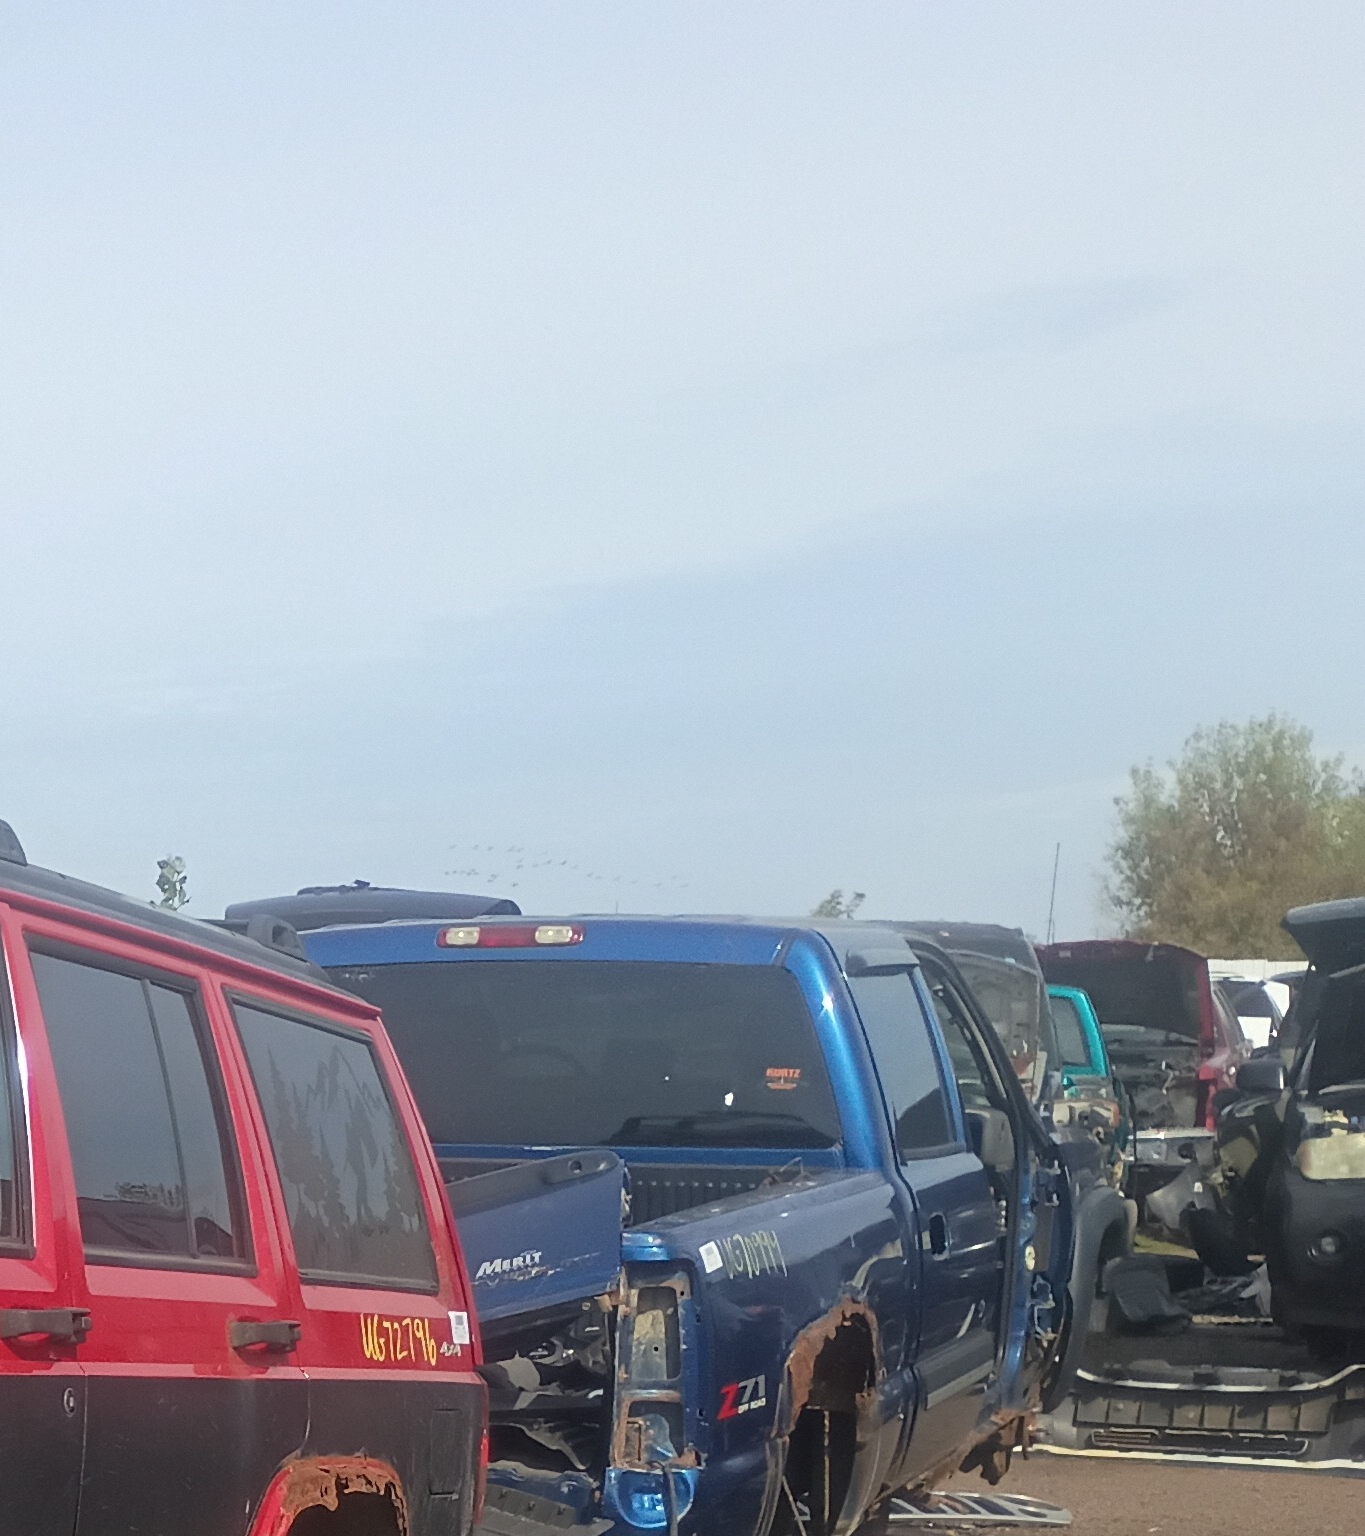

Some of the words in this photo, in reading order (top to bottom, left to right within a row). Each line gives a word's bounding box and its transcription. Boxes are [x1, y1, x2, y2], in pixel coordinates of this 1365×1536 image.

[360, 1312, 437, 1367] UG72796
[716, 1374, 766, 1421] Z71
[738, 1403, 749, 1414] OFF
[750, 1397, 766, 1409] ROAD
